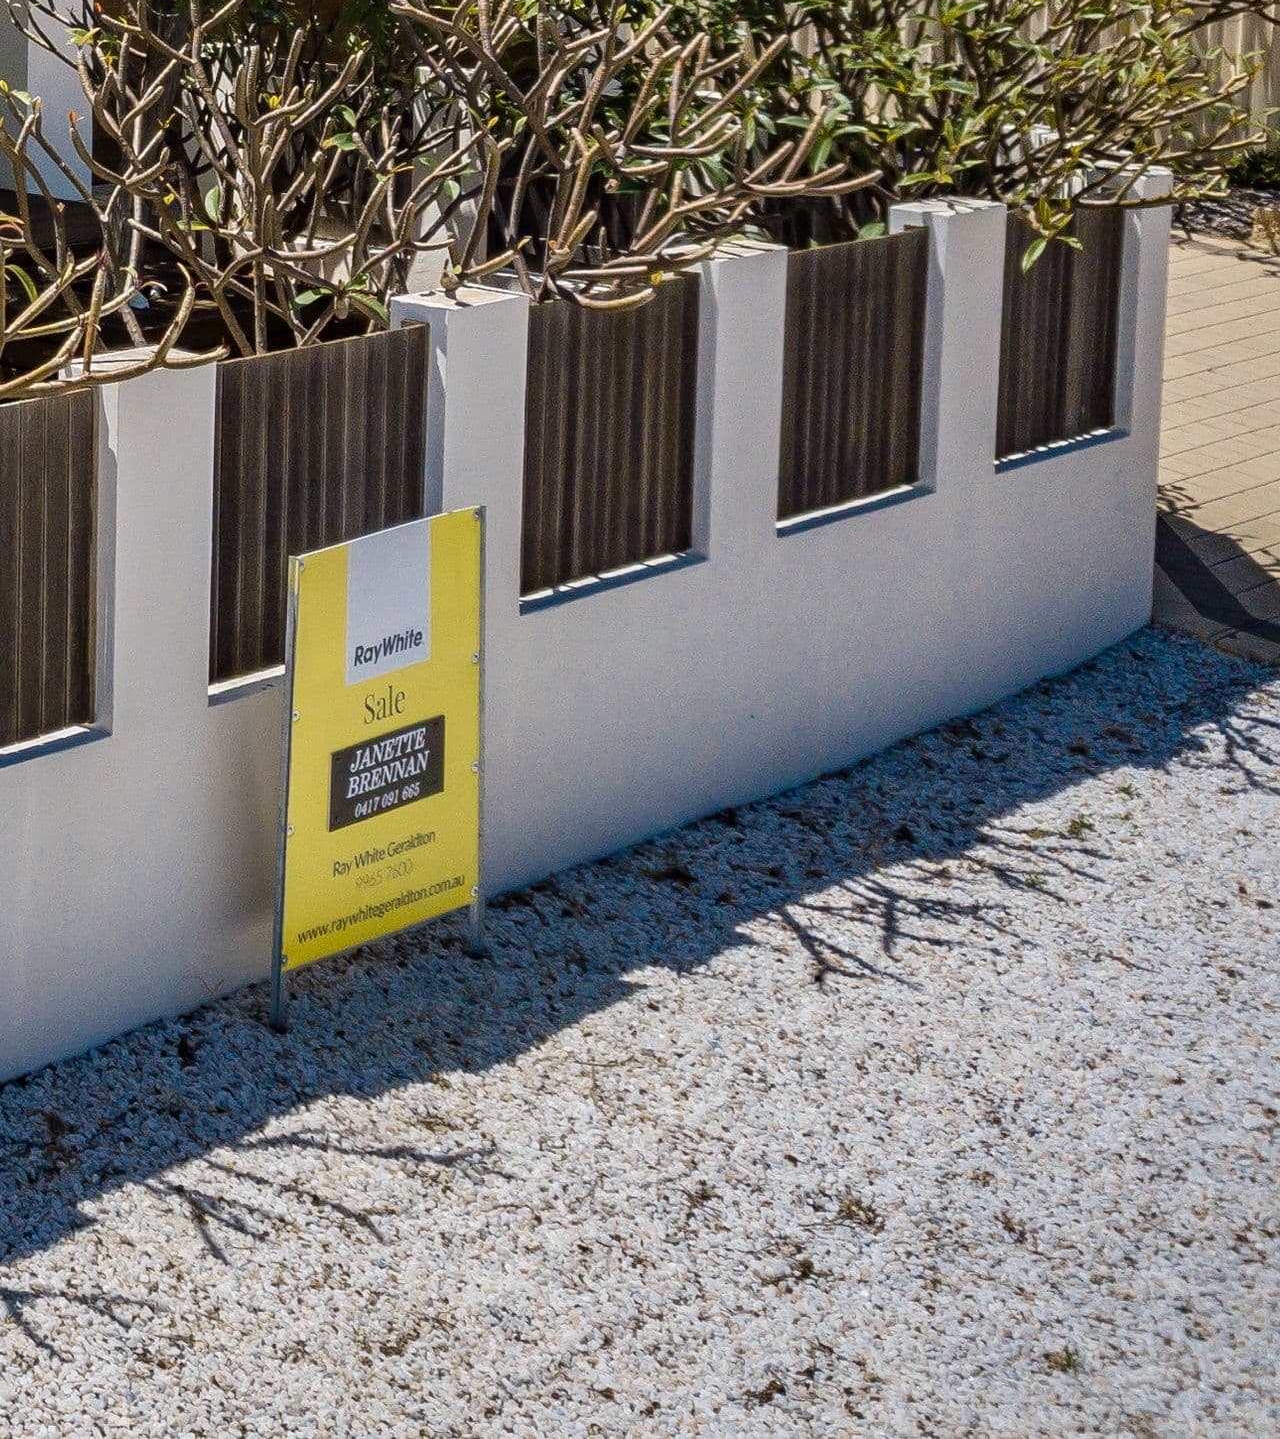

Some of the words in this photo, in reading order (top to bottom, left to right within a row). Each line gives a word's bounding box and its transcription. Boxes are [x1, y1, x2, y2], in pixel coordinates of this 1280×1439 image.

[364, 685, 406, 724] Sale
[350, 727, 426, 773] JANETTE
[346, 750, 430, 799] BRENNAN
[354, 797, 380, 818] 0417
[381, 789, 399, 808] 091
[333, 861, 353, 878] Ray
[354, 847, 386, 869] White
[387, 831, 436, 857] Geraldton
[297, 874, 465, 944] www.raywhitegeraldton.com.au
